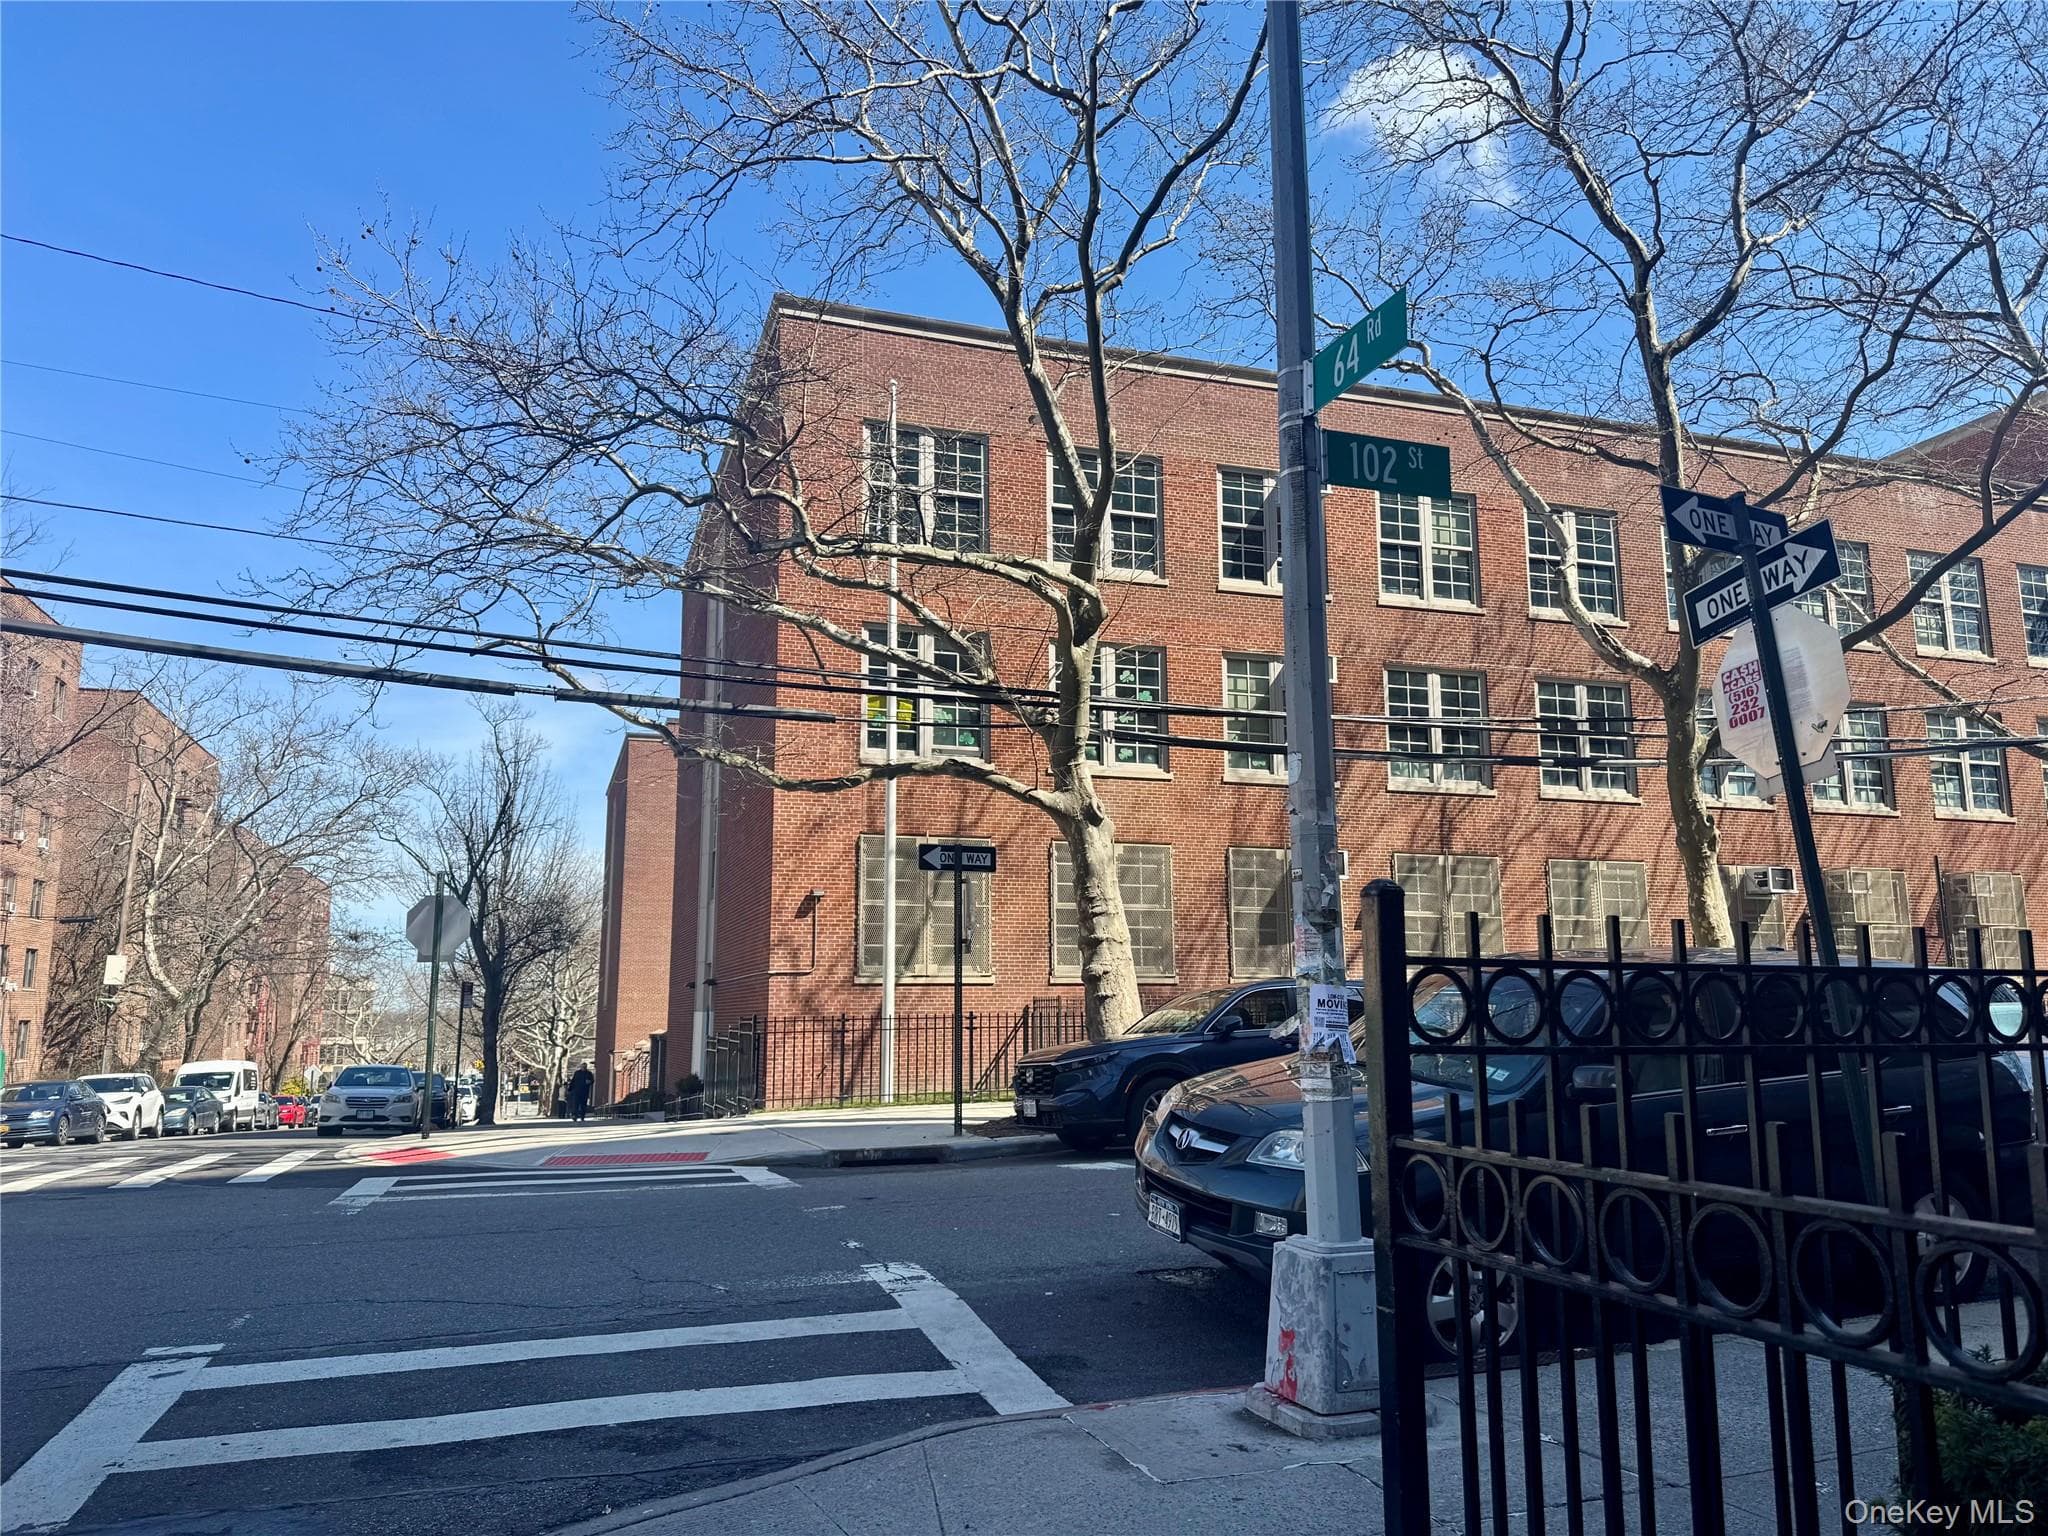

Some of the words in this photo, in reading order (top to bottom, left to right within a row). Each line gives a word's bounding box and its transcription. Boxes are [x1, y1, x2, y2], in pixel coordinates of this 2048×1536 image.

[1333, 332, 1360, 388] 64
[1366, 311, 1382, 344] Rd
[1350, 442, 1398, 485] 102
[1408, 446, 1424, 470] St
[1689, 508, 1730, 536] ONE
[1753, 524, 1772, 545] AY
[1707, 582, 1746, 619] ONE
[1763, 549, 1808, 591] WAY
[1724, 672, 1760, 691] 4CARS
[1729, 683, 1759, 704] (516)
[1731, 697, 1760, 715] 232
[1729, 706, 1765, 728] 0007
[940, 853, 955, 864] ON
[966, 853, 988, 864] WAY
[1317, 999, 1347, 1009] MOVI
